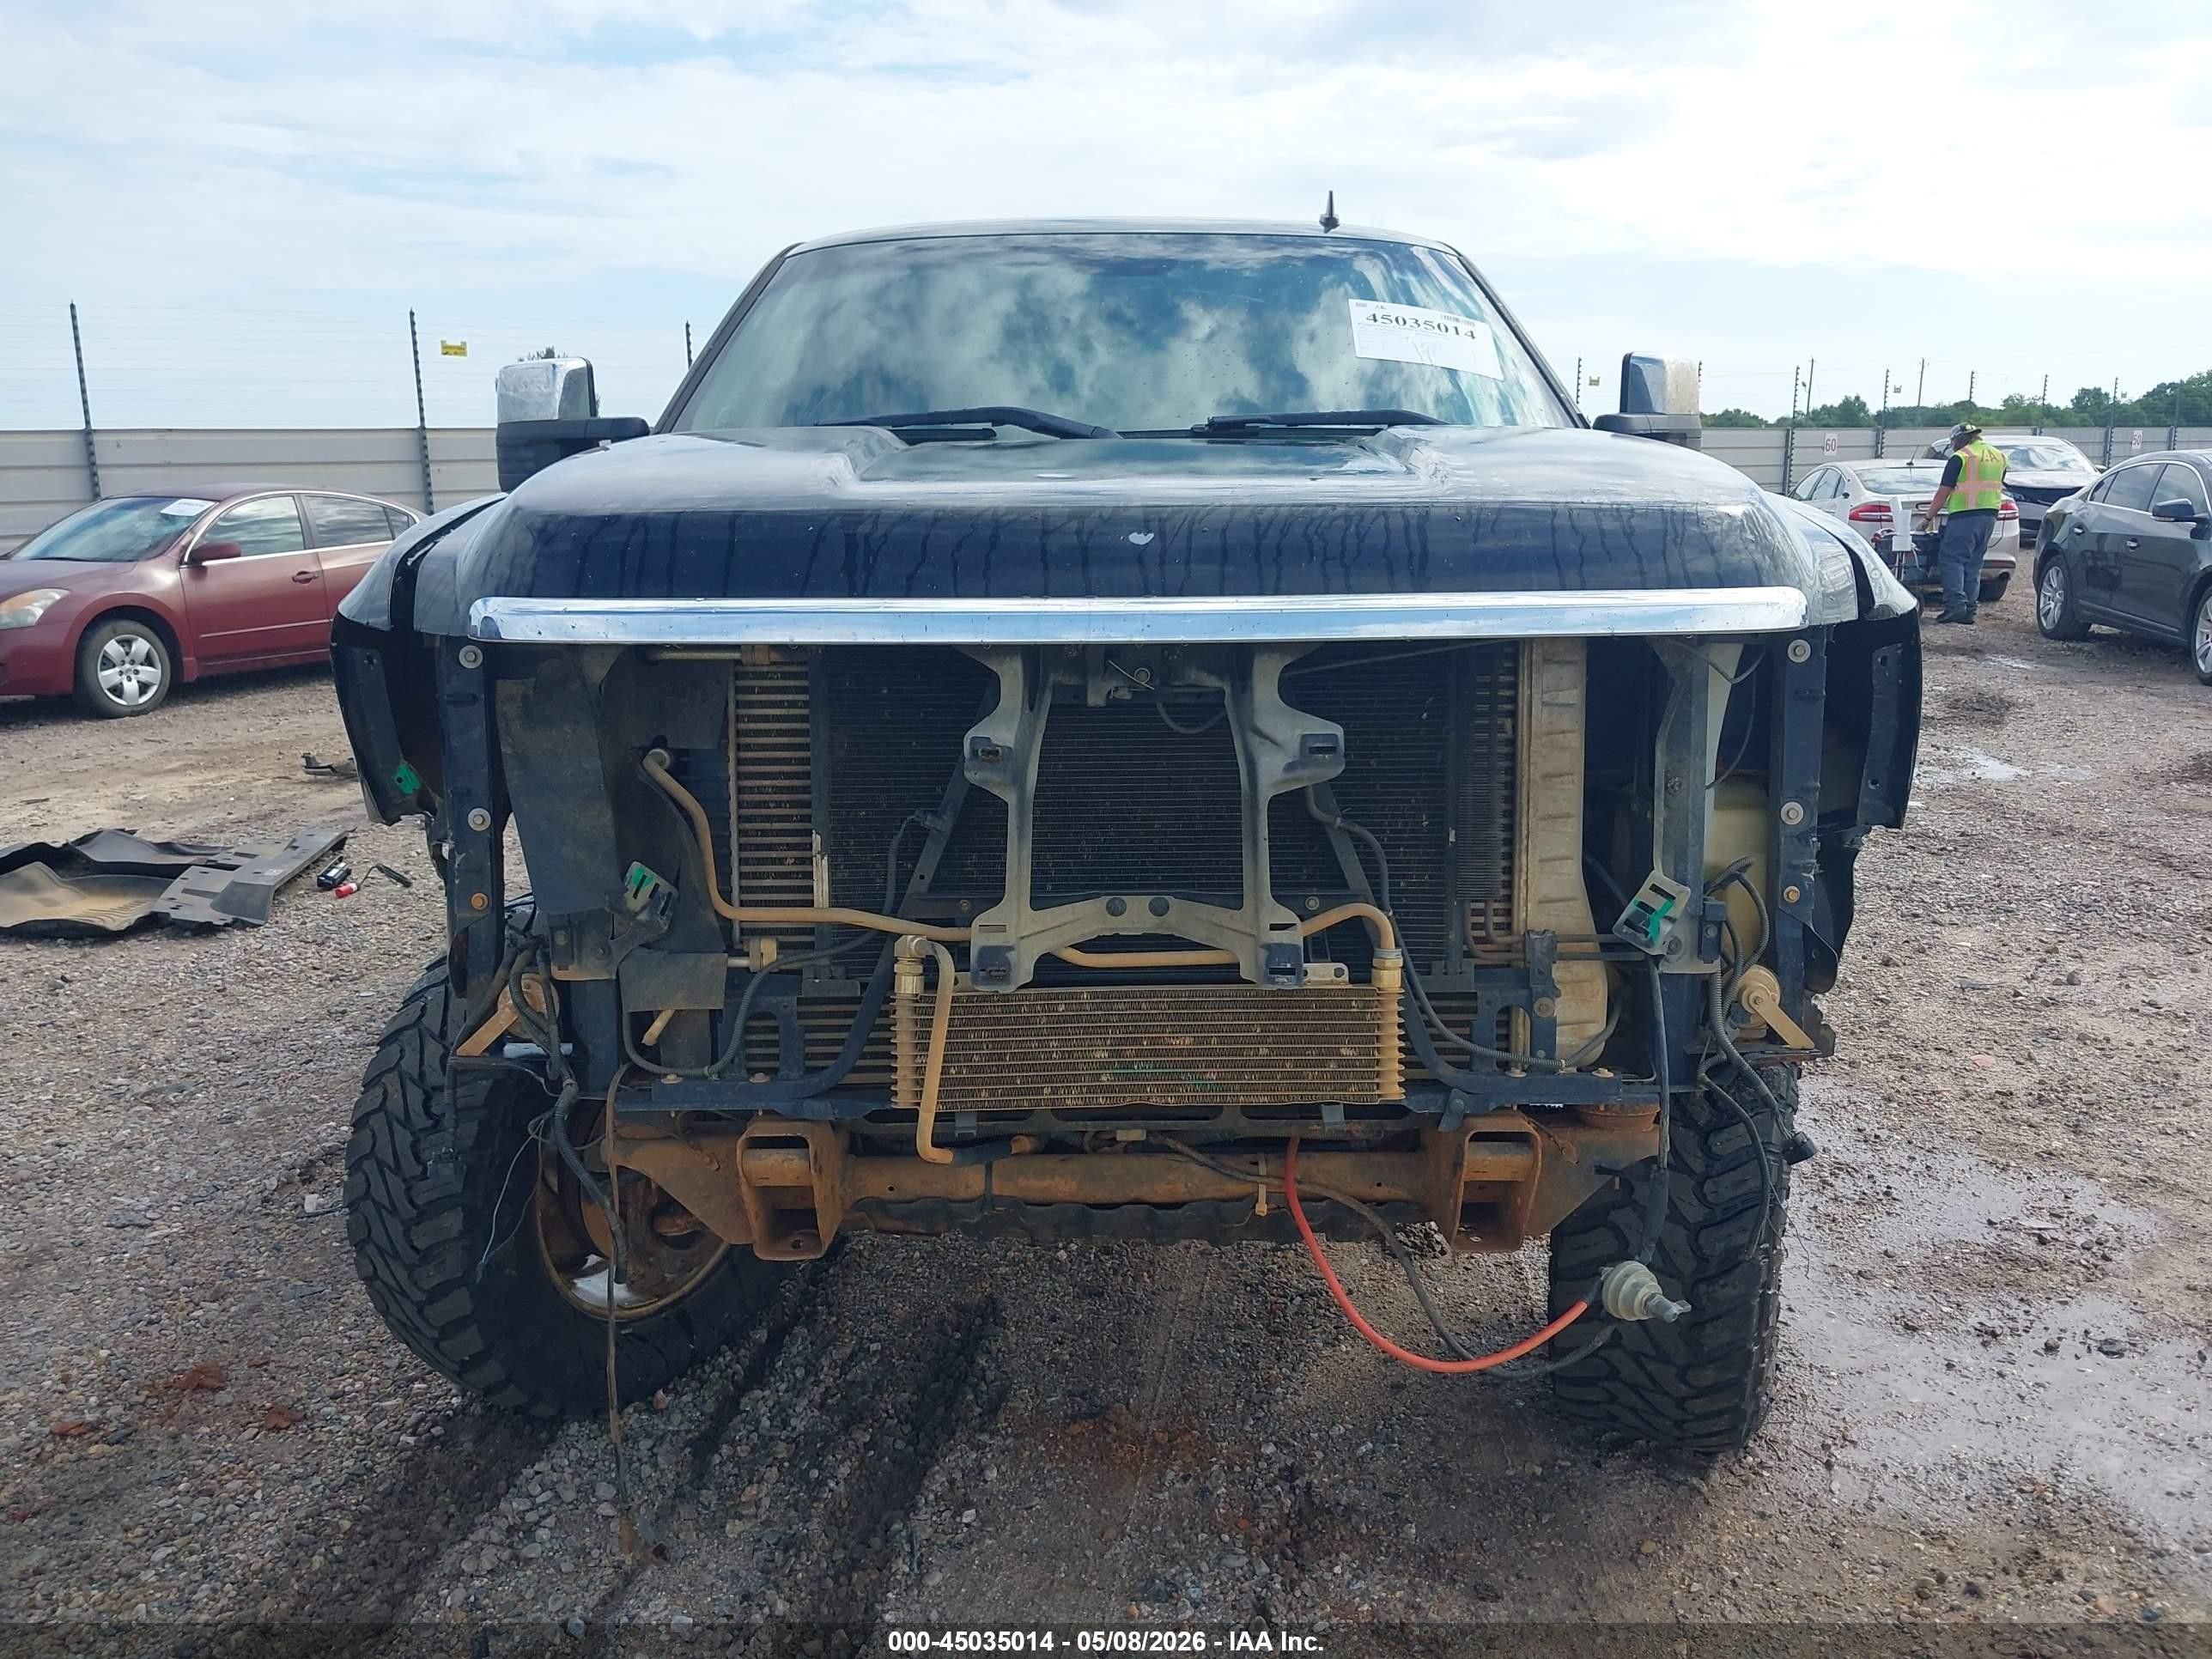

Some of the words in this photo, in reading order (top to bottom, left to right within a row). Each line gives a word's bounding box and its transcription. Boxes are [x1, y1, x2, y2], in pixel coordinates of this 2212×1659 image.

[1365, 313, 1476, 340] 45035014
[1825, 438, 1837, 452] 60
[2133, 434, 2142, 446] 50
